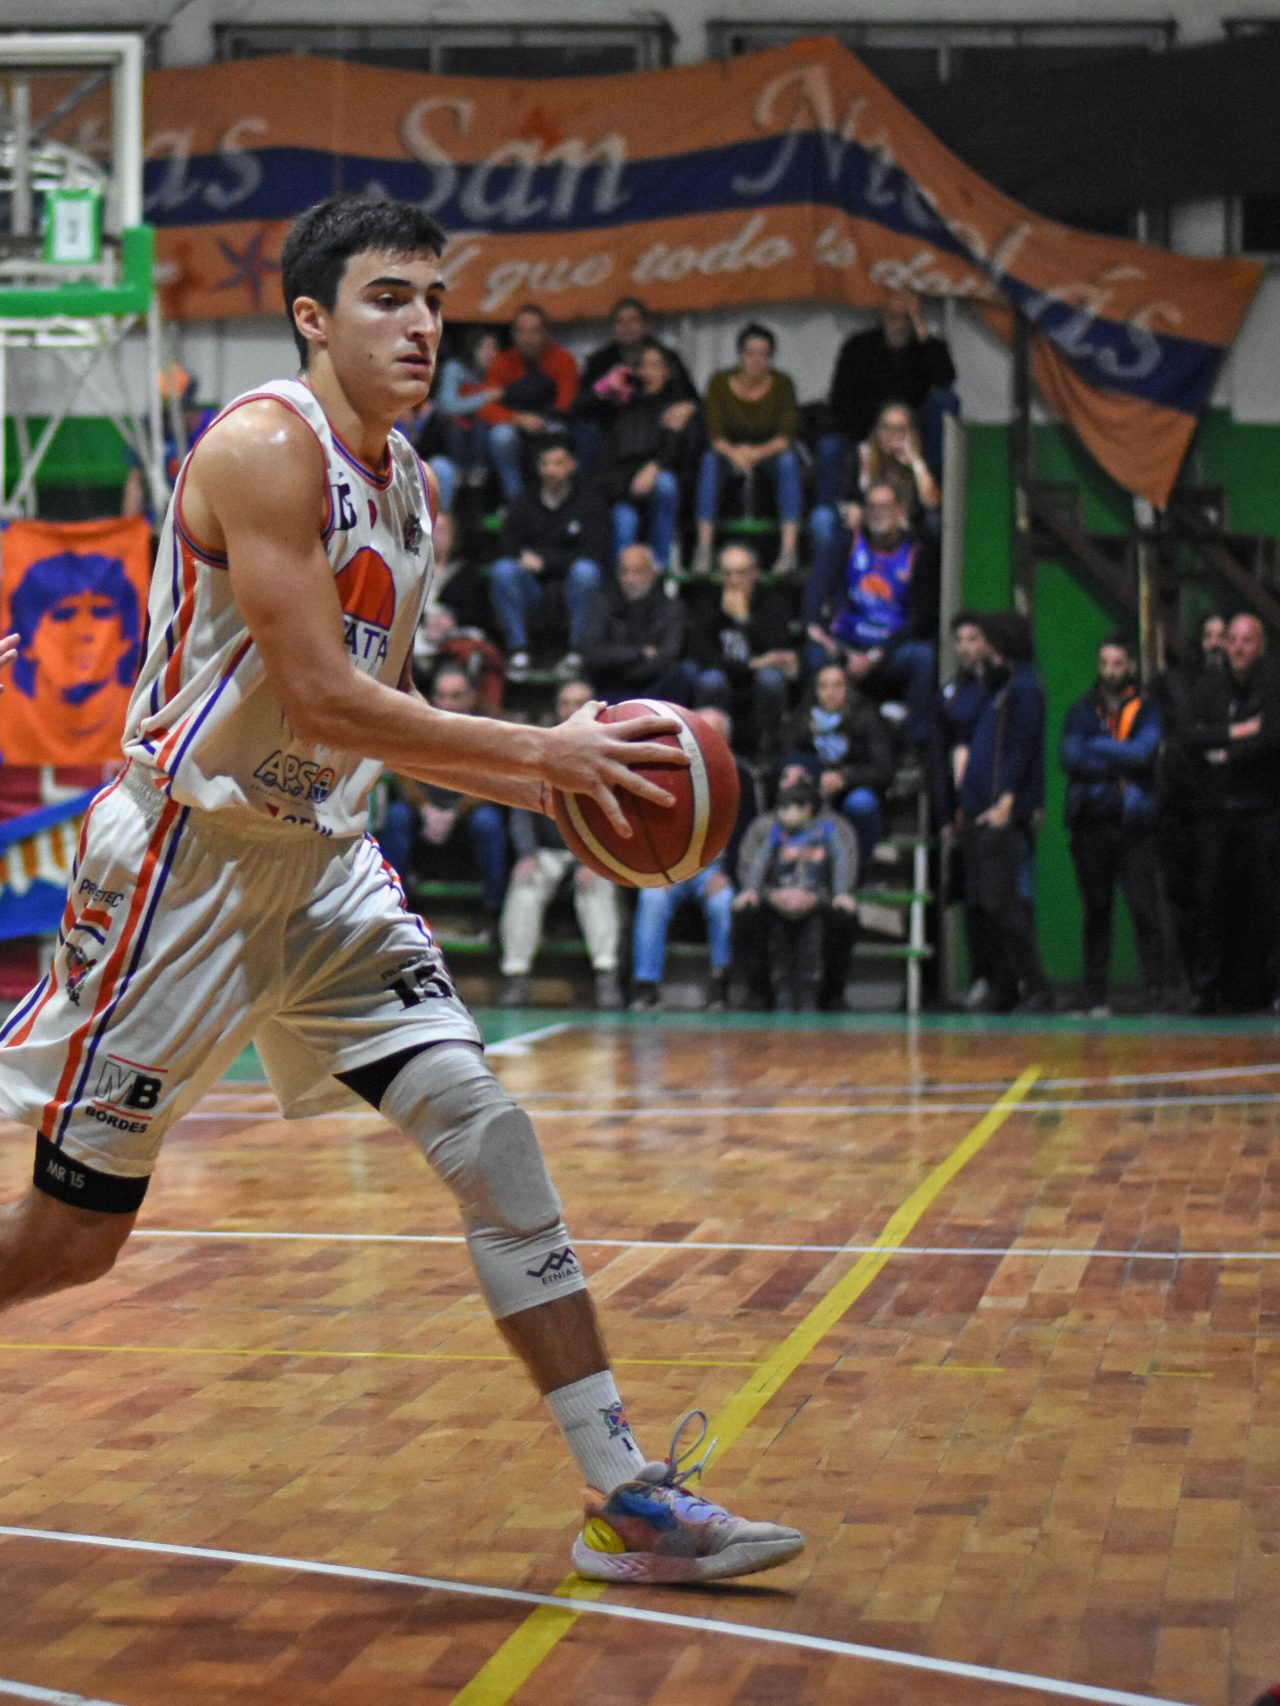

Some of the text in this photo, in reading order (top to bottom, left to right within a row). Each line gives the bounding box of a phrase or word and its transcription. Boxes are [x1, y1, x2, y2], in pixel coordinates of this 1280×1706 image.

[365, 97, 631, 222] San
[630, 214, 795, 285] todo
[383, 963, 453, 1012] 15
[95, 1060, 162, 1110] MB
[84, 1105, 149, 1134] BORDES
[70, 1170, 86, 1189] 15
